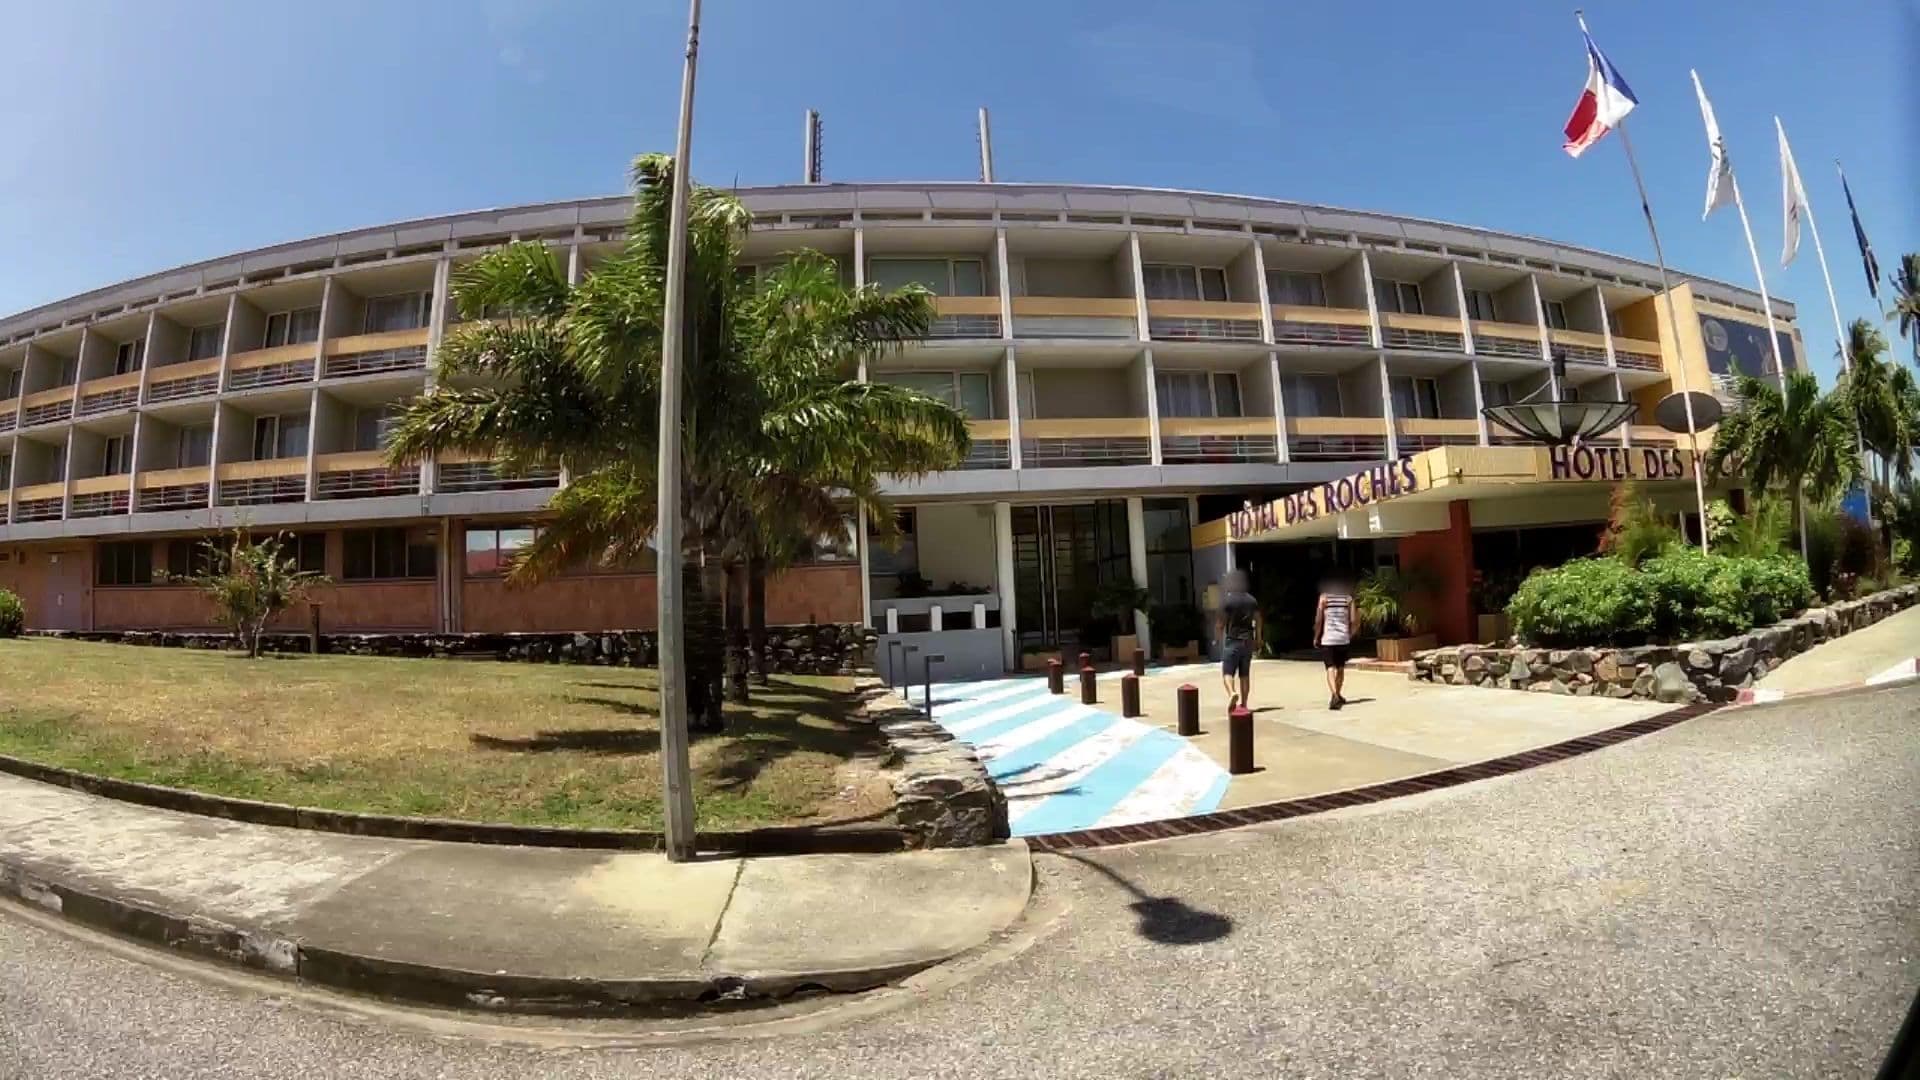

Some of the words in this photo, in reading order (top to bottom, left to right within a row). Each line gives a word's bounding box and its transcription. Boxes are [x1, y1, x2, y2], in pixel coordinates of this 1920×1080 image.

[1643, 449, 1684, 478] DES
[1283, 491, 1318, 525] DES
[1323, 458, 1417, 514] ROCHES
